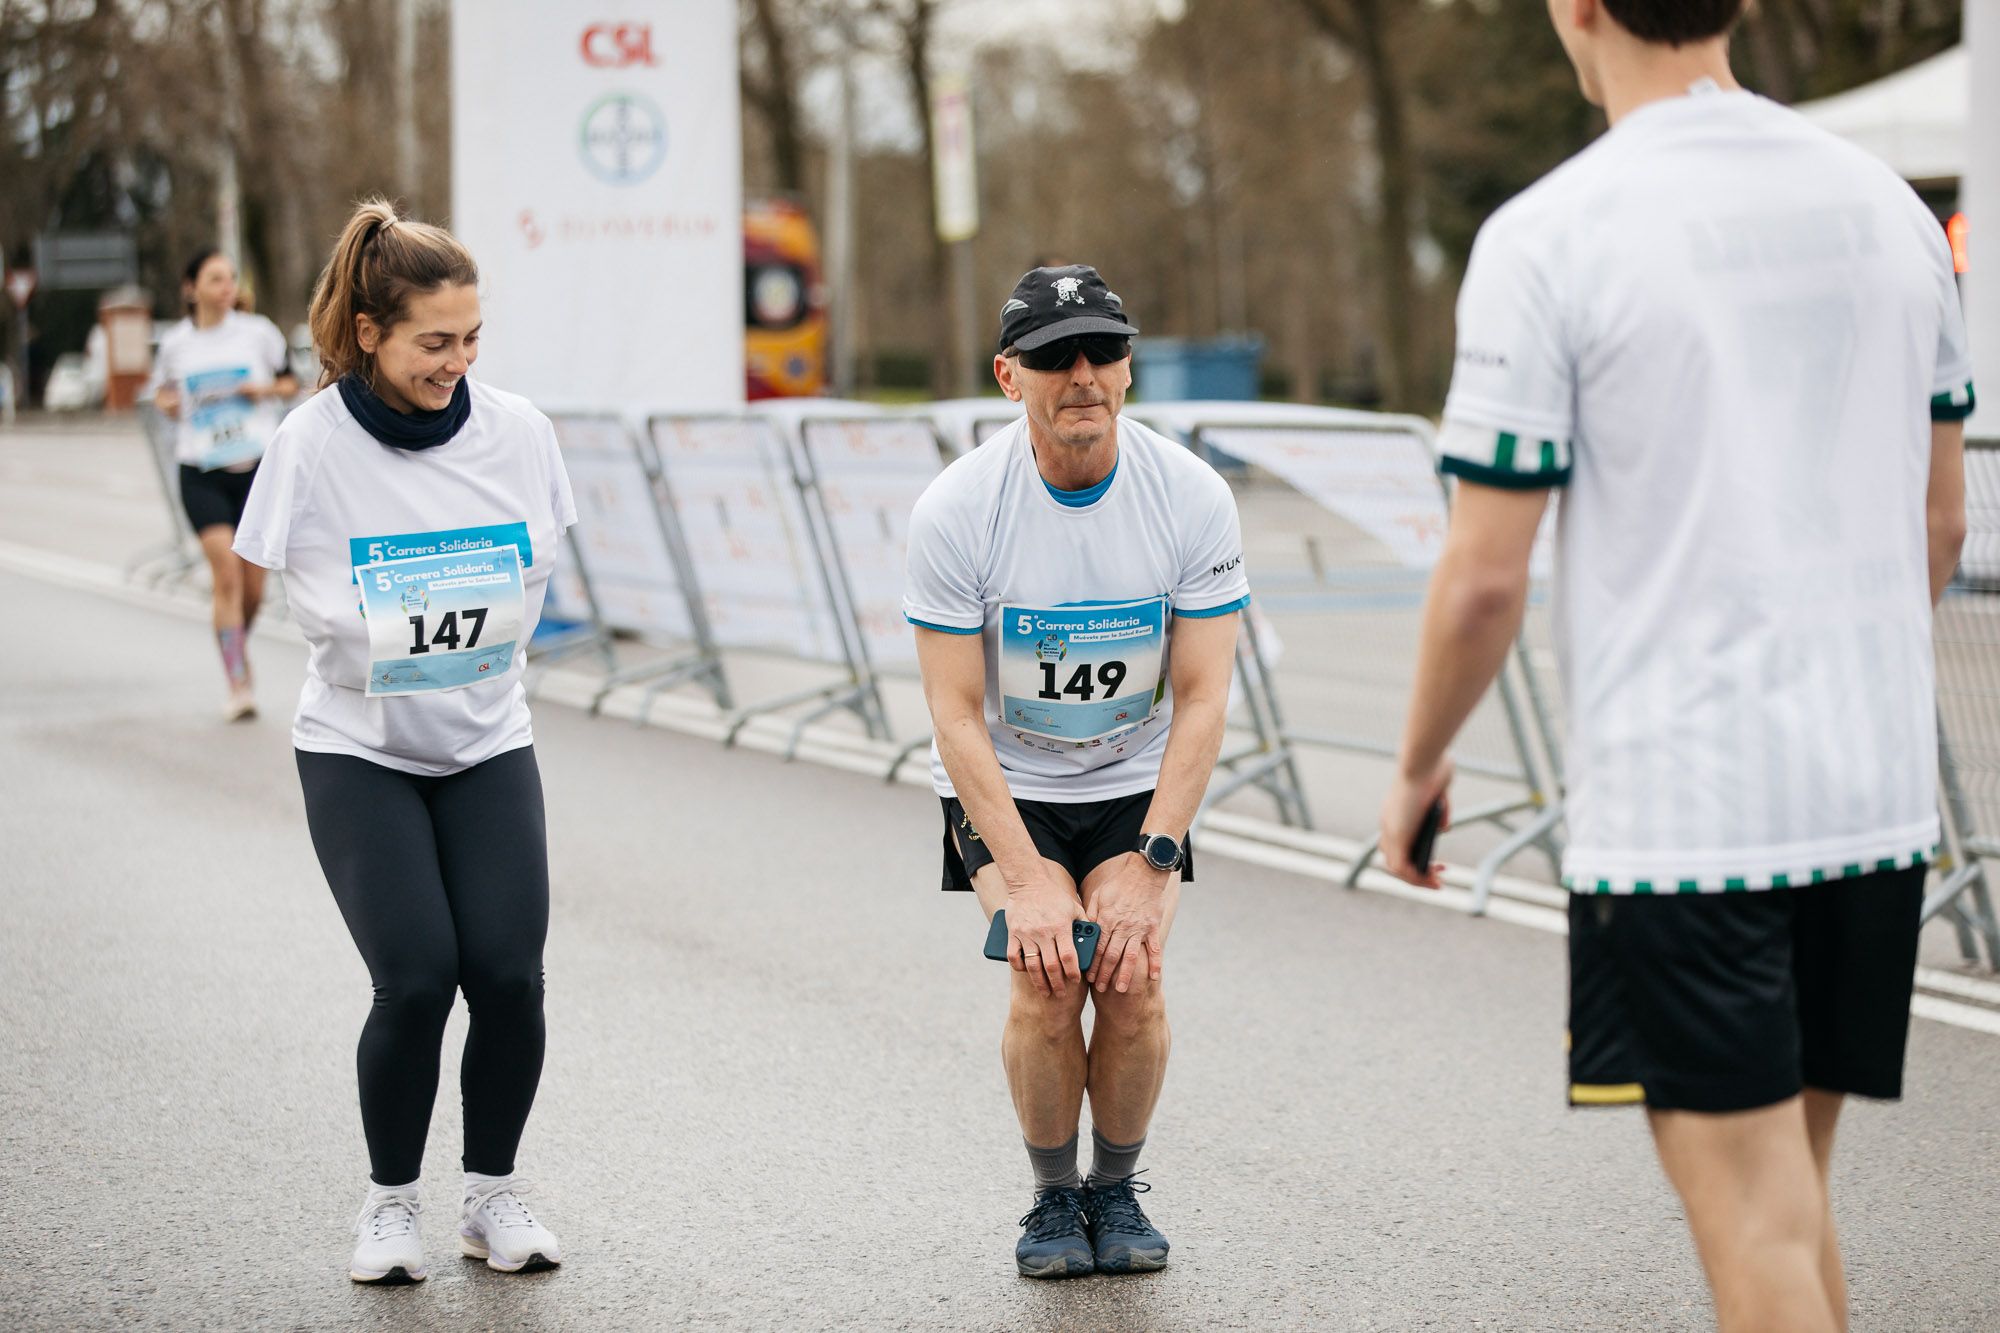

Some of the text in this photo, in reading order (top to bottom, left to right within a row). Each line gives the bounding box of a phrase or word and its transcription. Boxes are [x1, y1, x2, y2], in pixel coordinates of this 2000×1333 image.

[580, 24, 660, 68] CSL
[388, 544, 436, 557] Carrera
[440, 537, 493, 553] Solidaria
[394, 572, 440, 584] Carrera
[443, 562, 494, 578] Solidaria
[1213, 552, 1244, 576] MUK
[409, 608, 489, 655] 147
[1036, 620, 1084, 631] Carrera
[1088, 617, 1140, 631] Solidaria
[1038, 660, 1127, 701] 149
